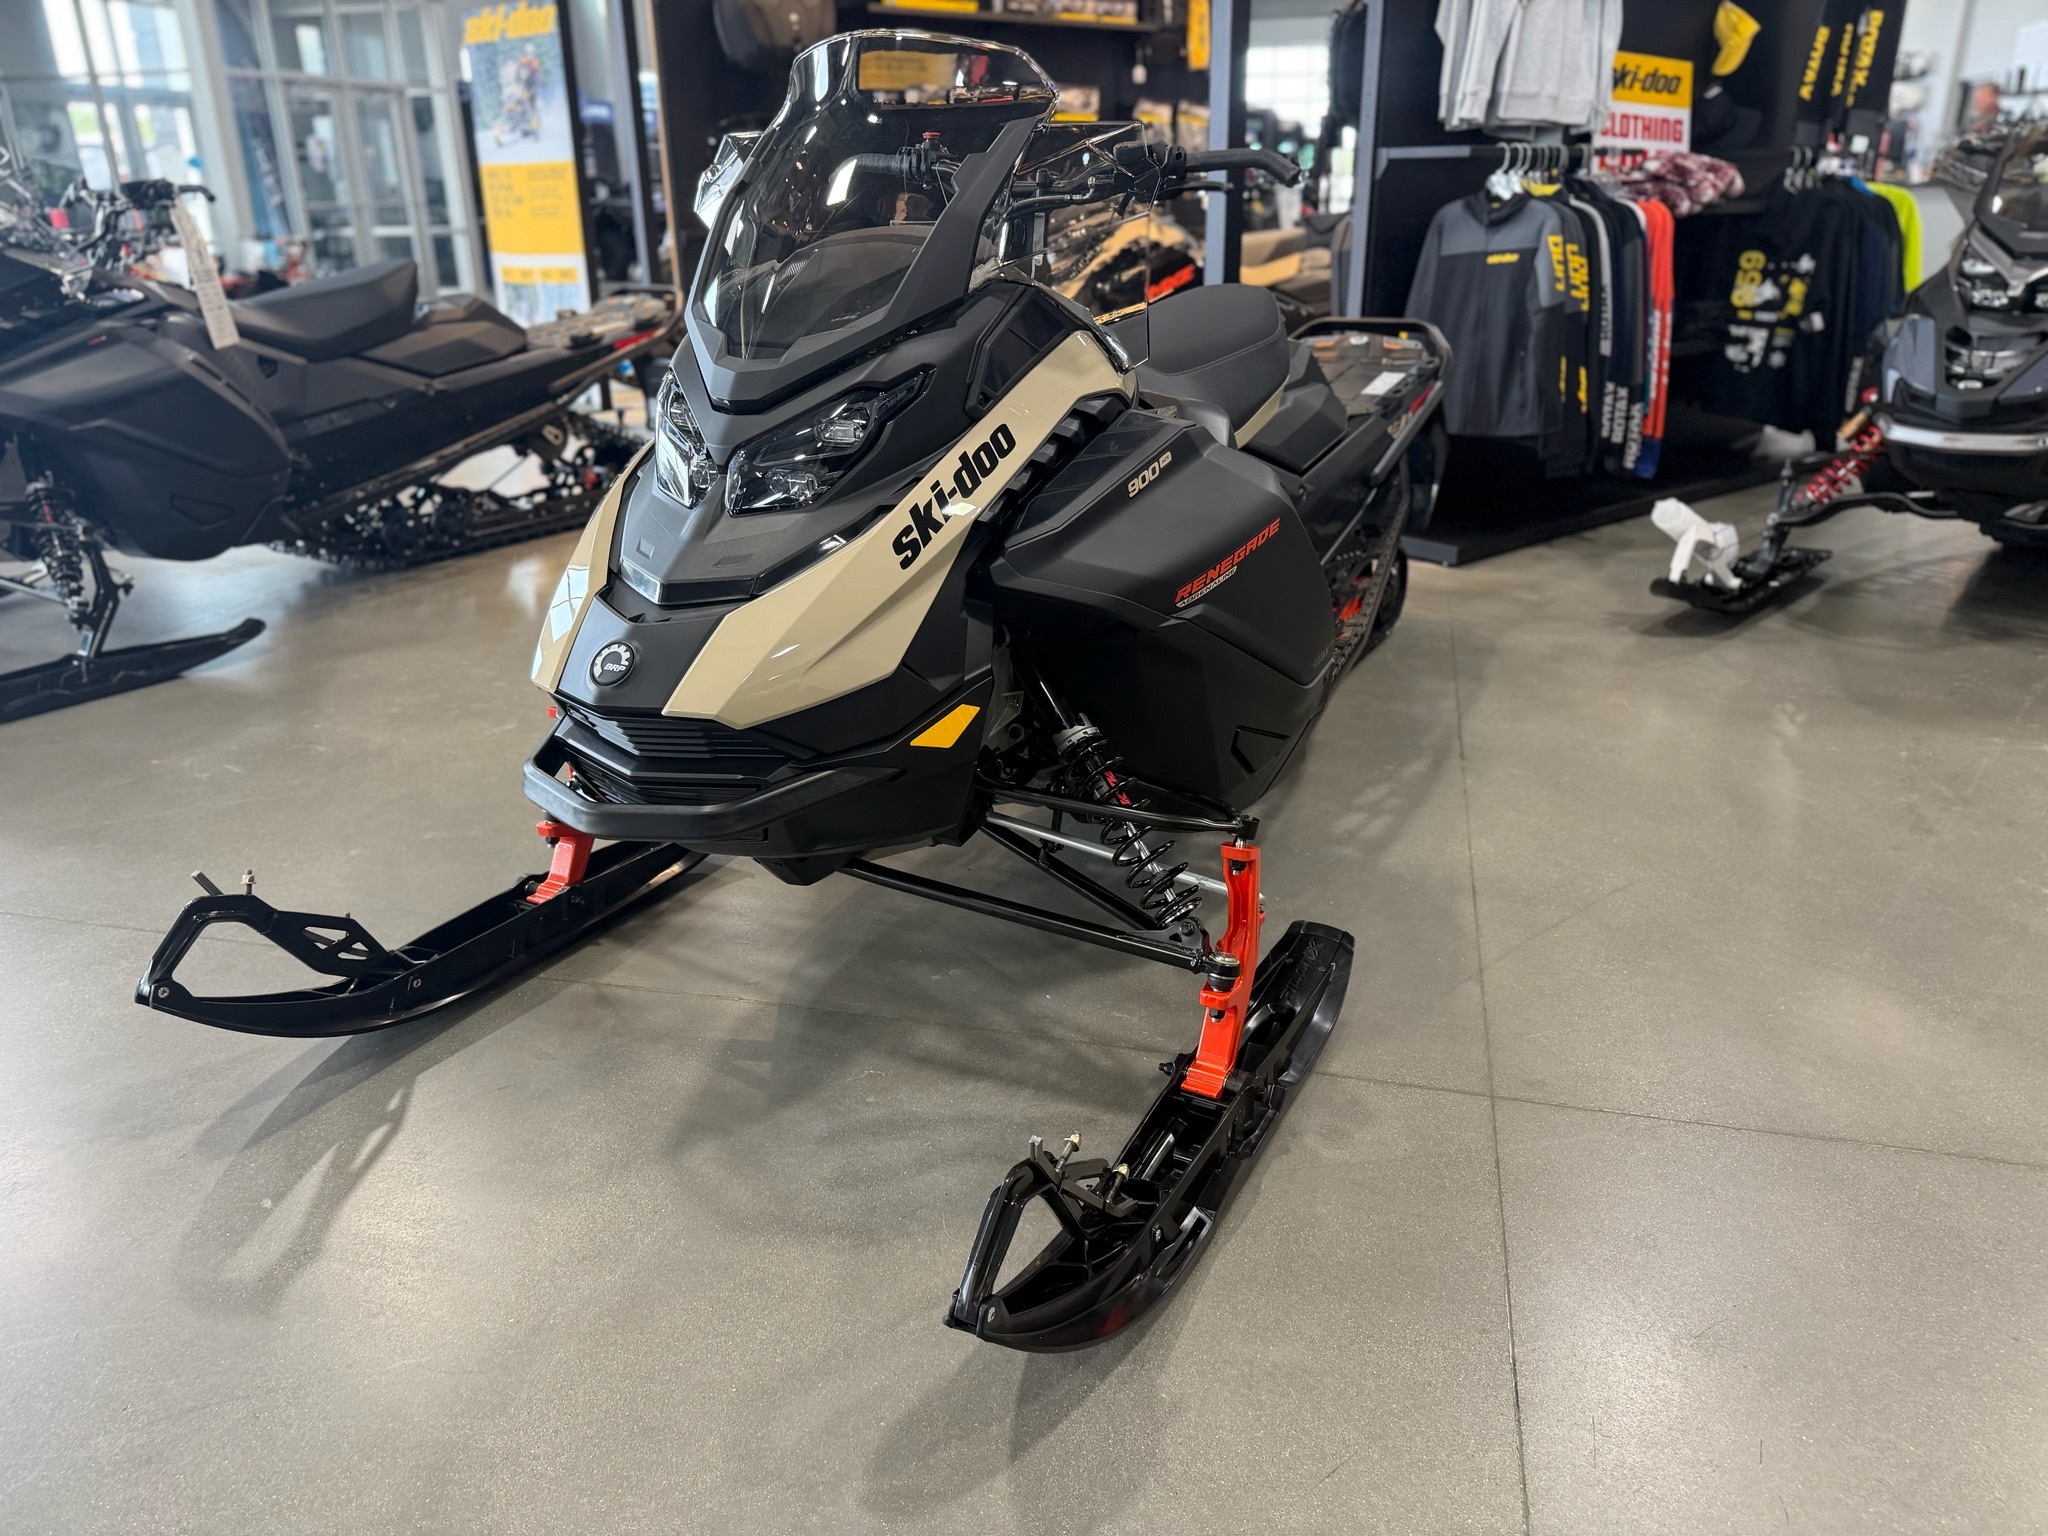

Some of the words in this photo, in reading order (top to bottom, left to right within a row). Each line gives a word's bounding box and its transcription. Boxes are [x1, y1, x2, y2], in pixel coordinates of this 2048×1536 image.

[892, 423, 1017, 571] ski-doo
[1128, 461, 1160, 498] 900
[1175, 518, 1280, 603] RENEGADE
[1179, 568, 1236, 607] ADRENALINE
[603, 662, 627, 672] BRP
